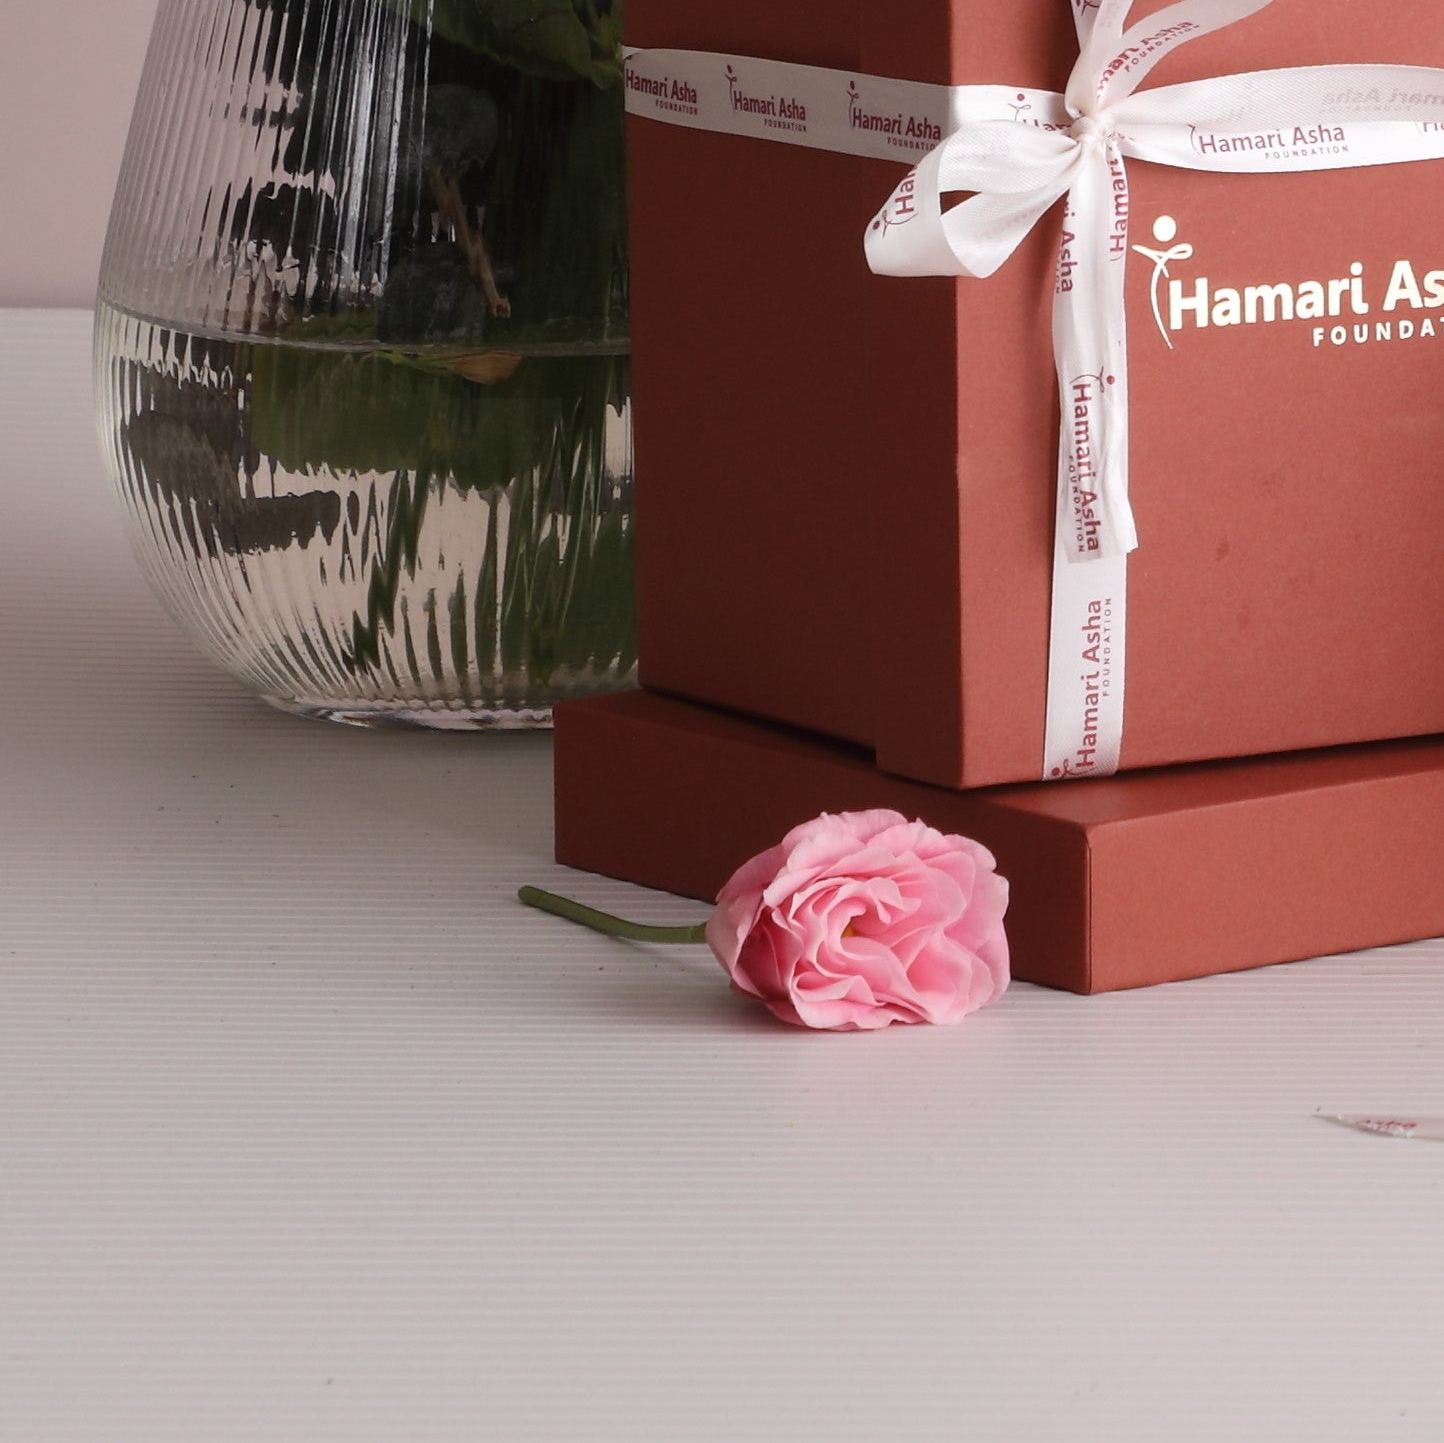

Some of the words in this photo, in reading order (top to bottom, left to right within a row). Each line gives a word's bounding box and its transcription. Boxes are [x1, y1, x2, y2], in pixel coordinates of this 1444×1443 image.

[625, 68, 667, 97] Hamari
[671, 82, 697, 104] Asha
[655, 100, 698, 116] FOUNDATION
[733, 90, 775, 117] Hamari
[779, 97, 806, 121] Asha
[764, 118, 807, 133] FOUNDATION
[852, 107, 902, 135] Hamari
[905, 116, 941, 141] Asha
[887, 136, 937, 152] FOUNDATIO
[1199, 127, 1286, 154] Hamari
[1292, 123, 1346, 145] Asha
[1265, 144, 1349, 160] FOUNDATION
[1107, 159, 1128, 253] Hamari
[1061, 230, 1077, 293] Asha
[1169, 261, 1369, 330] Hamari
[1072, 383, 1096, 481] Hamari
[1069, 455, 1084, 552] FOUNDATION
[1080, 490, 1101, 551] Asha
[1082, 600, 1101, 662] Asha
[1103, 597, 1112, 696] FOUNDATION
[1076, 669, 1099, 769] Hamari
